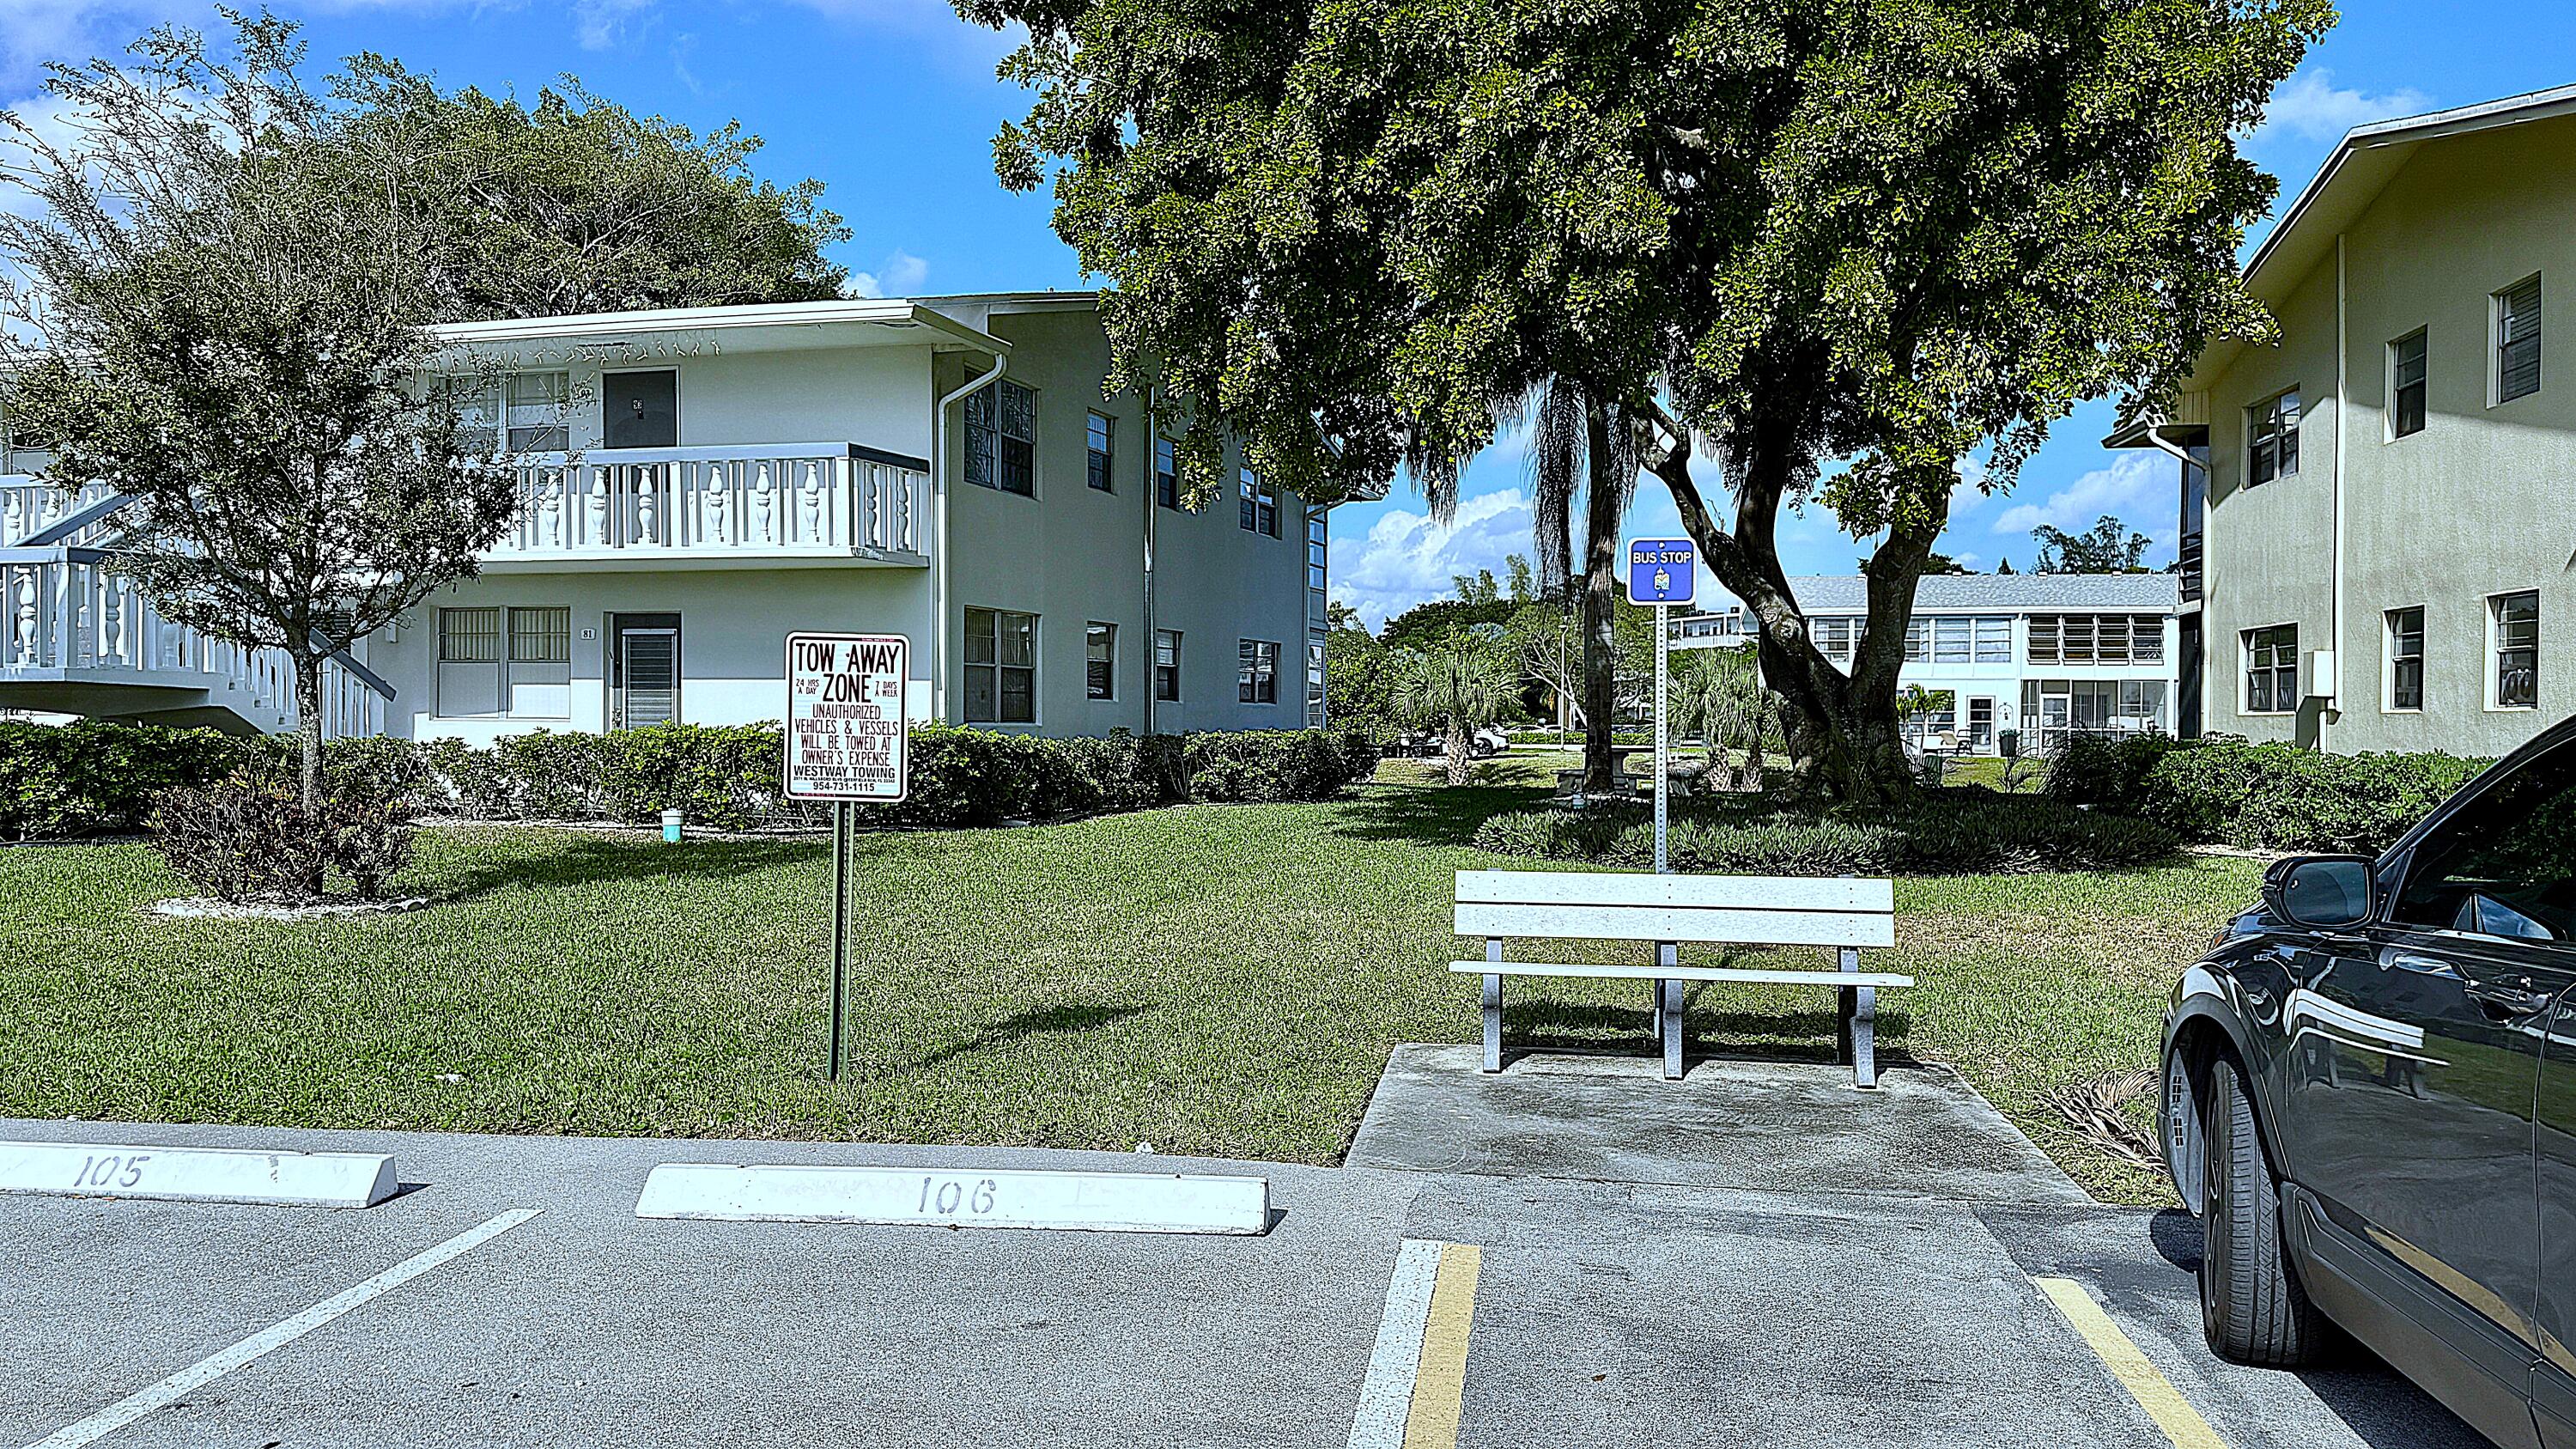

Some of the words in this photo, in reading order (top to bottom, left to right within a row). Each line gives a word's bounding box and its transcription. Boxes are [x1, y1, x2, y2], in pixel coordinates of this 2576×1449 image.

[1632, 551, 1658, 564] BUS
[1660, 551, 1692, 564] STOP
[583, 630, 592, 638] 81
[795, 642, 835, 673] TOW
[847, 644, 900, 674] AWAY
[795, 678, 805, 687] 24
[807, 679, 820, 687] HRS
[823, 673, 872, 703] ZONE
[875, 680, 879, 690] 7
[883, 680, 897, 690] DAYS
[798, 686, 803, 695] A
[805, 686, 817, 695] DAY
[874, 689, 879, 697] A
[882, 689, 898, 697] WEEK
[812, 703, 881, 719] UNAUTHORIZED
[794, 718, 837, 734] VEHICLES
[844, 721, 853, 735] &
[859, 721, 898, 736] VESSELS
[800, 734, 822, 750] WILL
[828, 735, 840, 750] BE
[846, 736, 876, 751] TOWED
[881, 736, 892, 752] AT
[801, 750, 843, 765] OWNER'S
[849, 752, 890, 766] EXPENSE
[793, 764, 849, 777] WESTWAY
[851, 766, 896, 779] TOWING
[812, 782, 875, 792] 954-731-1115
[74, 1155, 150, 1188] 105
[918, 1176, 997, 1215] 106
